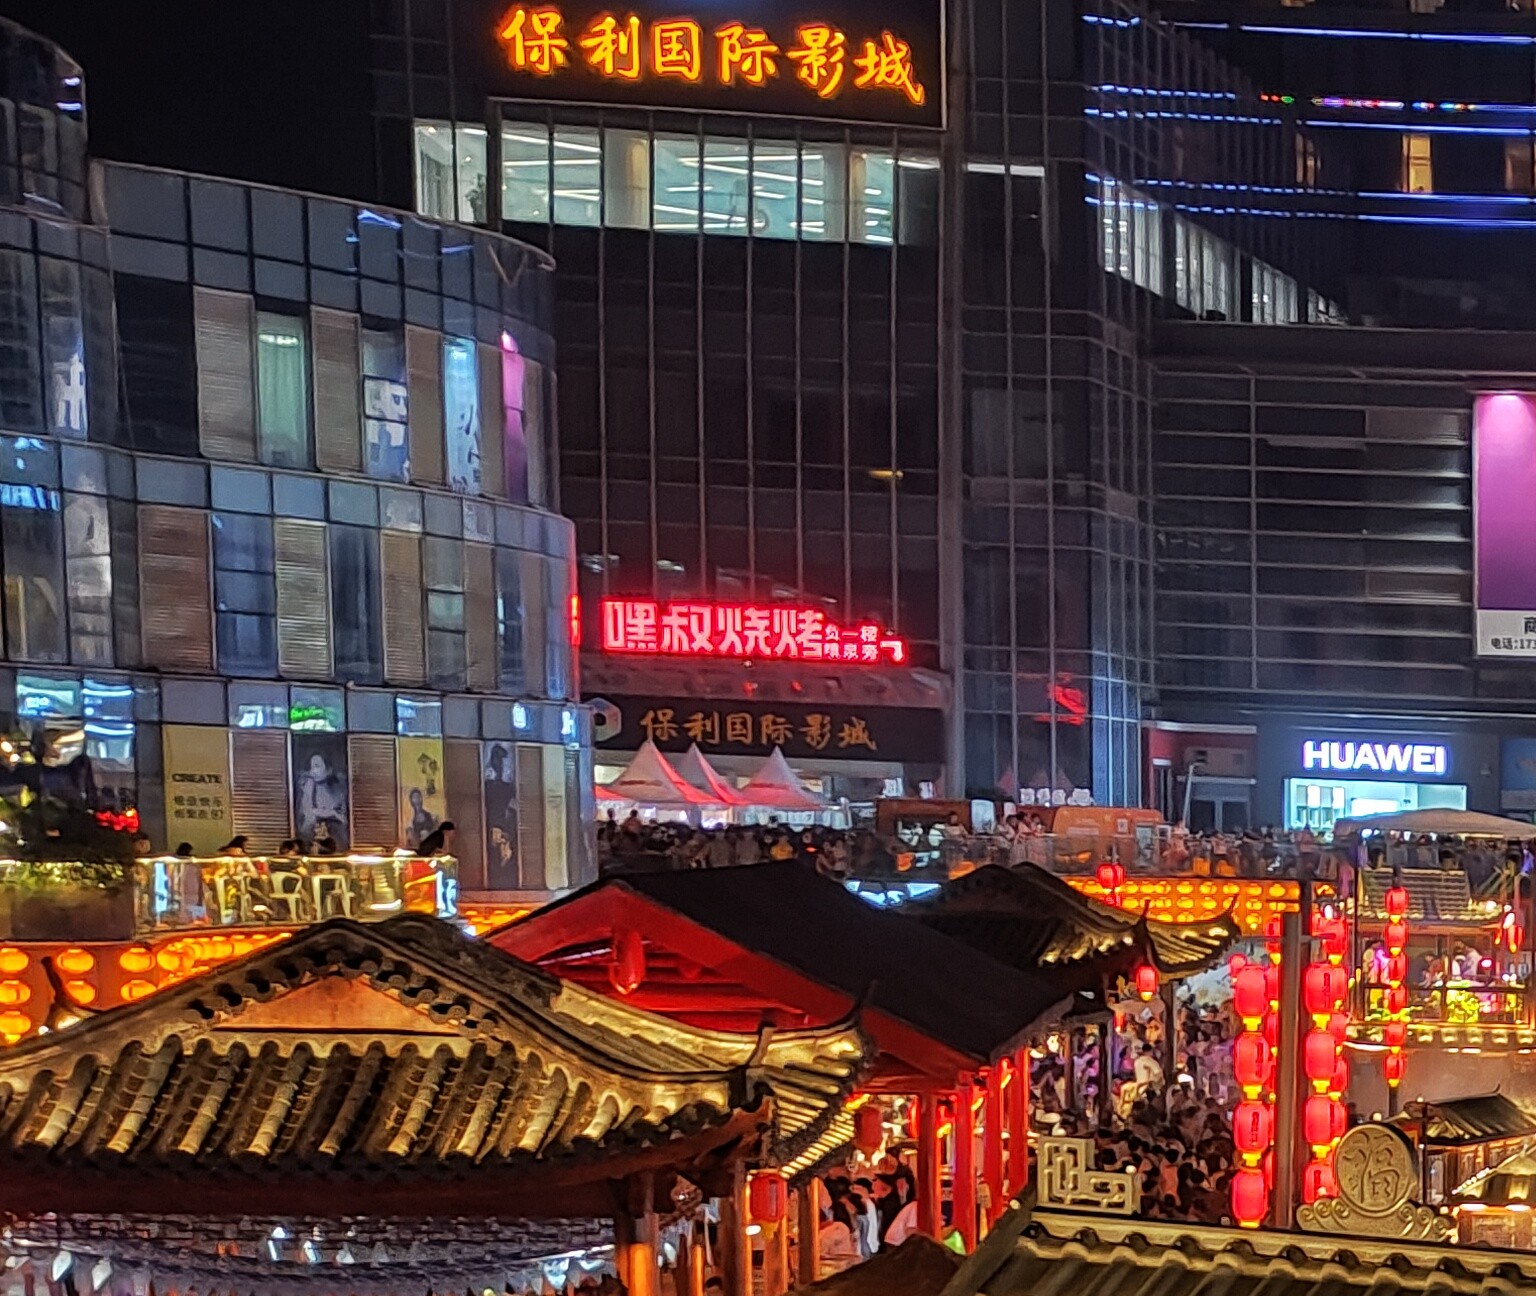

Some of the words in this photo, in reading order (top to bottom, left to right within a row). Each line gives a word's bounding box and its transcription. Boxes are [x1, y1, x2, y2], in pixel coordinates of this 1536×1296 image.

[500, 9, 925, 105] 保利国际影城
[604, 601, 825, 658] 嘿叔烧烤
[639, 707, 878, 750] 保利国际影城
[1303, 740, 1447, 773] HUAWEI
